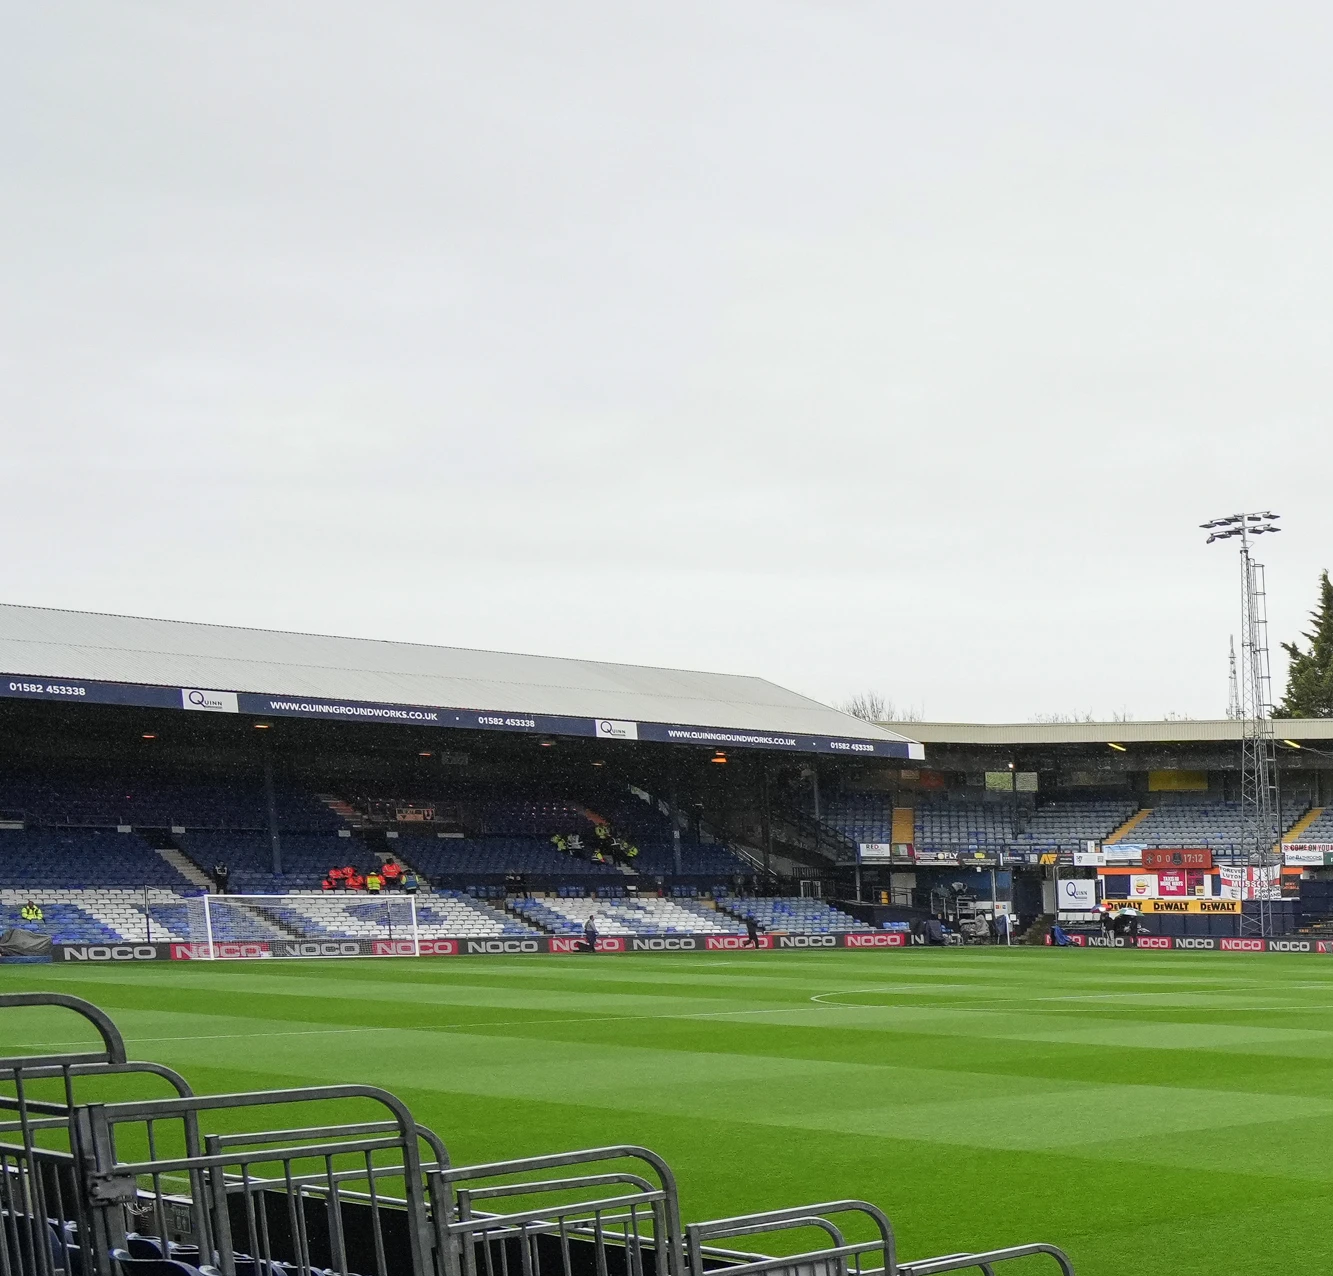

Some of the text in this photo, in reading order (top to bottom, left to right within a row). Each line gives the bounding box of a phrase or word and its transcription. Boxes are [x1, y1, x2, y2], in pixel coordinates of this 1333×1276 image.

[9, 682, 86, 696] 01582 453338
[270, 700, 535, 728] WWW.QUINNGROUNDWORKS.CO.UK 01582 453338
[668, 730, 796, 747] WWW.QUINNGROUNDWORKS.CO.UK
[830, 742, 850, 751] 01582
[1157, 853, 1203, 863] 0 0 17:12
[468, 940, 539, 953] NOCO
[633, 938, 696, 950] NOCO
[780, 936, 836, 947] NOCO
[847, 934, 901, 946] NOCO
[1176, 938, 1215, 949] NOCO
[1222, 939, 1262, 950] NOCO
[1269, 940, 1310, 951] NOCO
[64, 946, 157, 961] NOCO
[176, 944, 260, 959] NOCO
[286, 943, 360, 956] NOCO
[376, 941, 453, 954] NOCO
